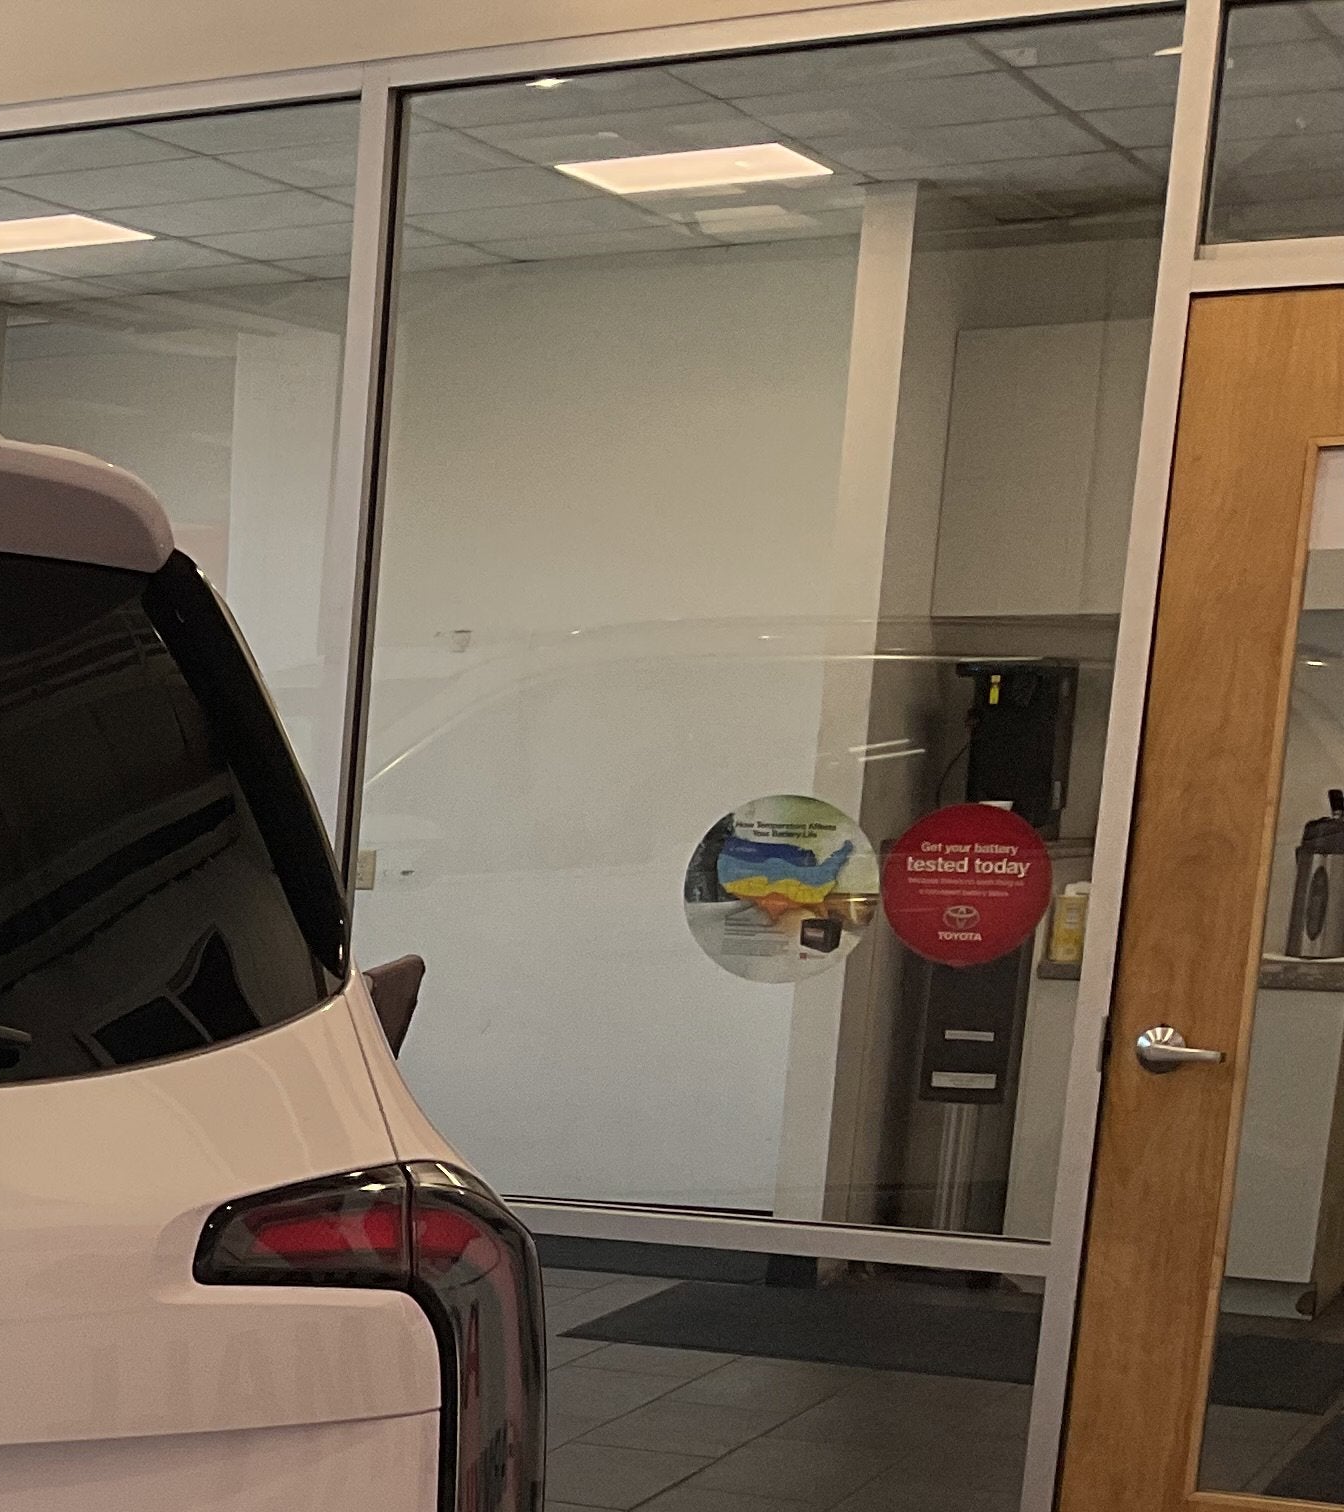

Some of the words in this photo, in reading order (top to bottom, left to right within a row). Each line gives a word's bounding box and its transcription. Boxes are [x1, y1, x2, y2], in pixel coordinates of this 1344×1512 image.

[921, 841, 943, 852] Get
[945, 843, 972, 854] your
[974, 843, 1019, 856] battery
[907, 856, 969, 873] tested
[974, 858, 1031, 878] today
[938, 931, 982, 941] TOYOTA
